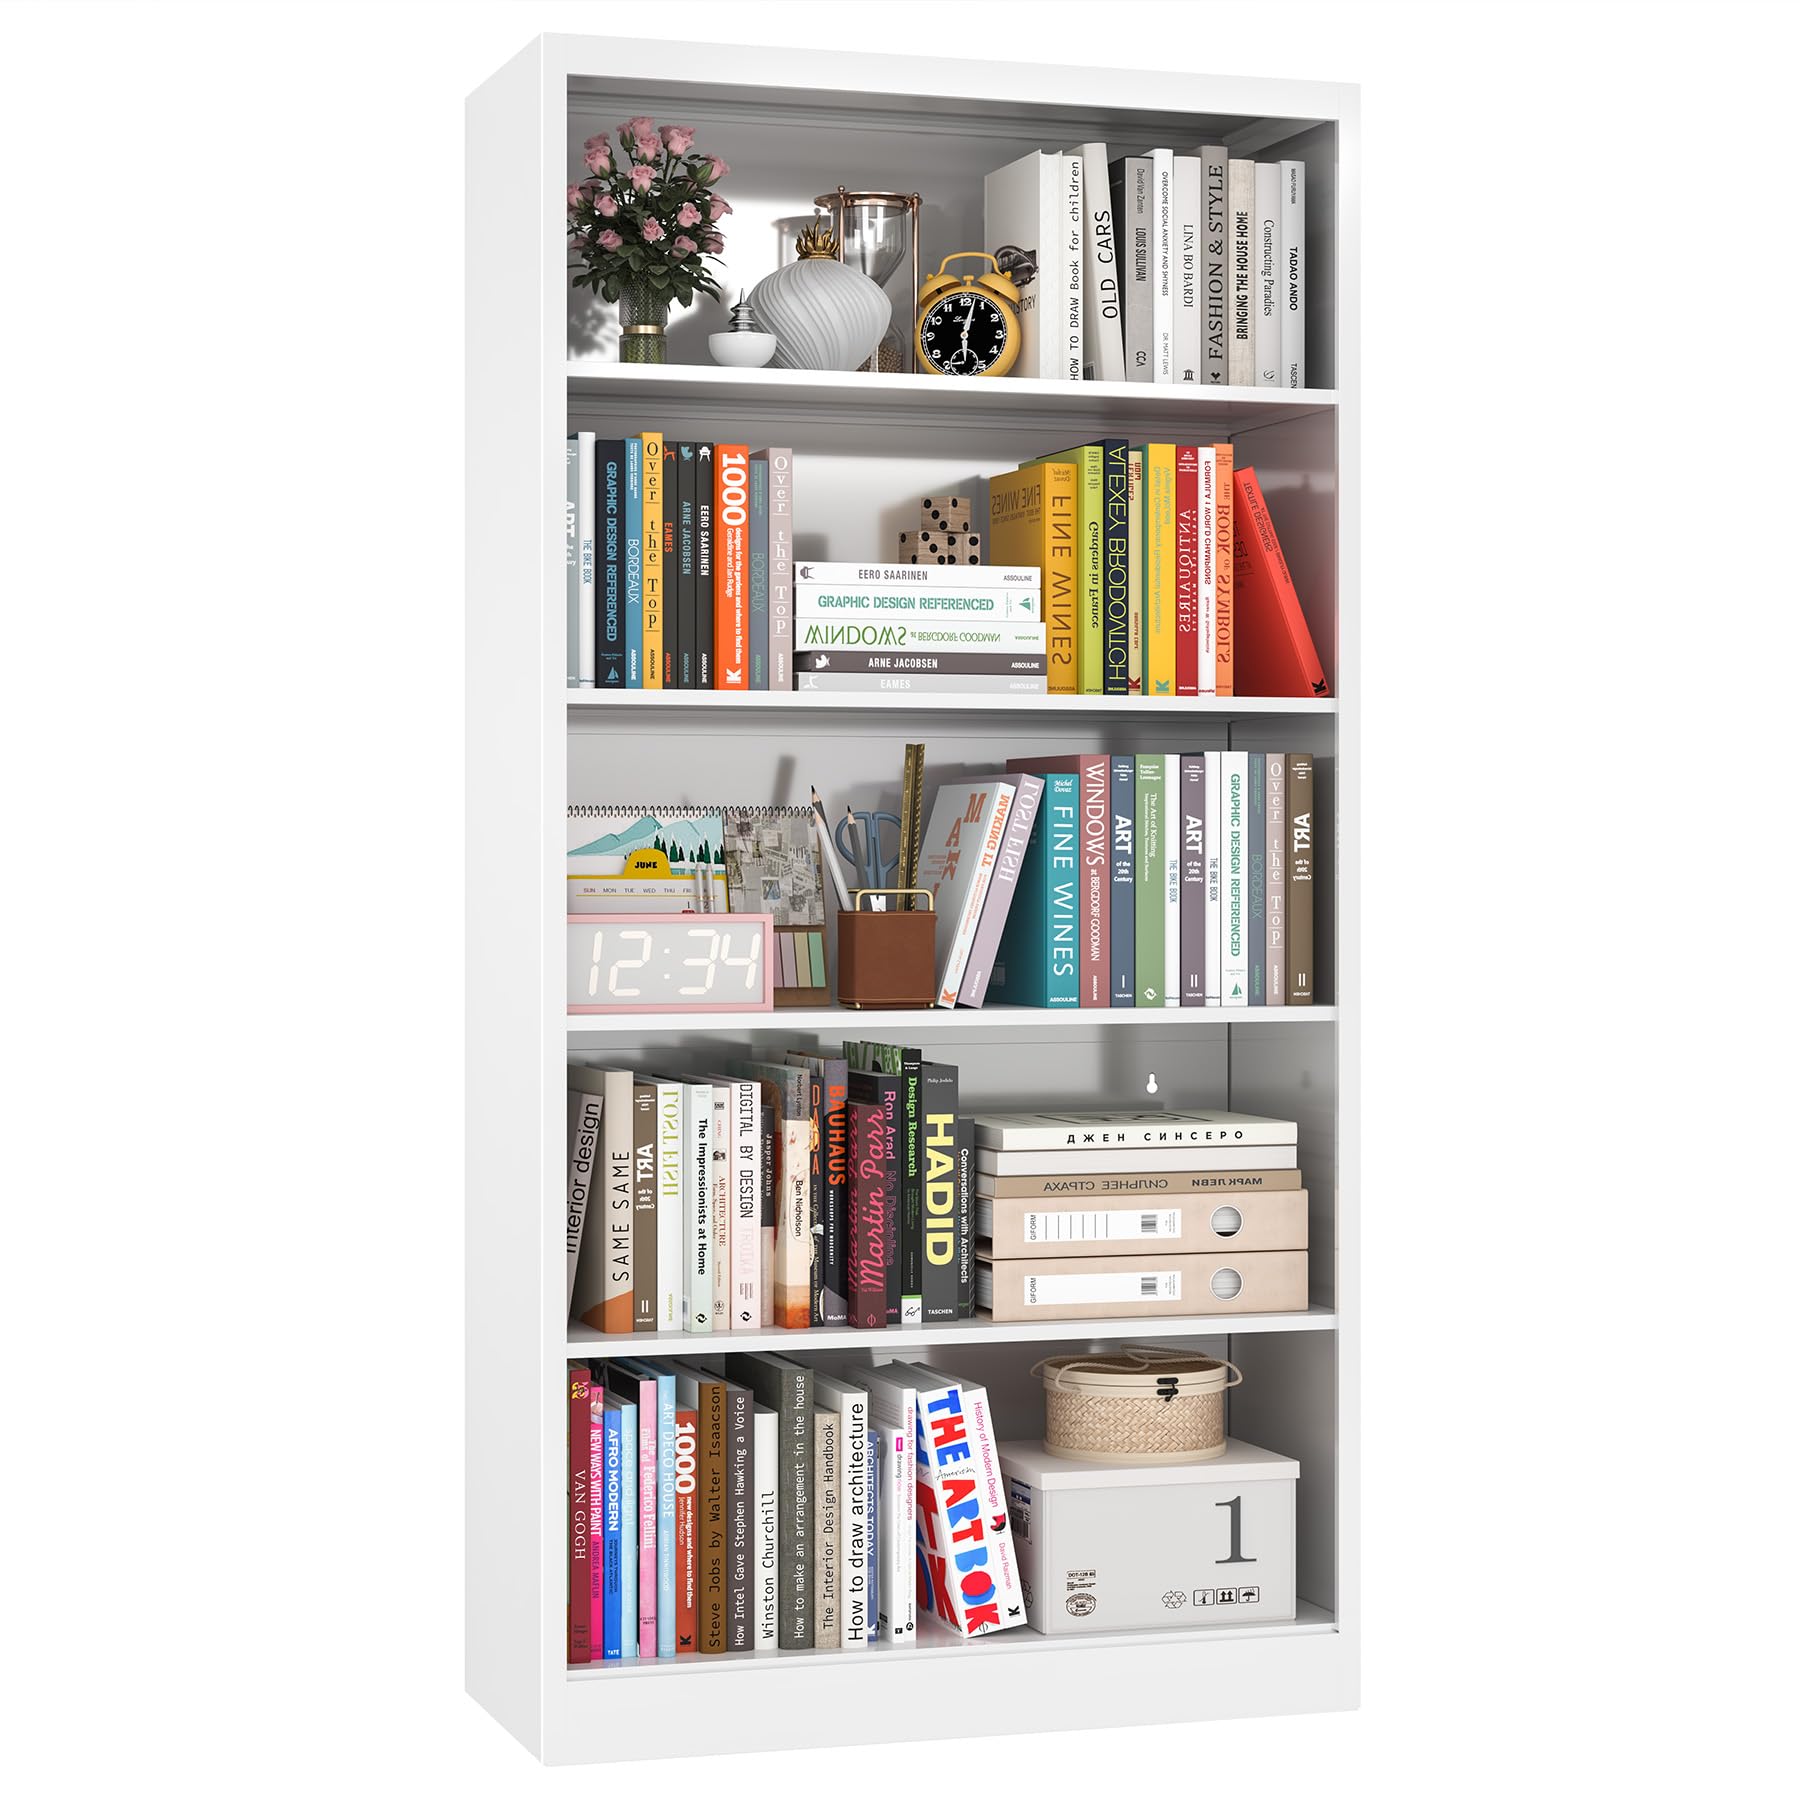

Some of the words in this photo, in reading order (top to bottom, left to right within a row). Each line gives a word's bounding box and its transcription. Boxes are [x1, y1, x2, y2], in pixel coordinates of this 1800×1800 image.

[1069, 162, 1080, 222] children
[1208, 166, 1222, 232] STYLE
[1069, 230, 1080, 252] for
[1094, 210, 1114, 263] CARS
[1136, 228, 1146, 248] LOUIS
[1184, 224, 1194, 250] LINA
[1236, 212, 1248, 238] HOME
[1136, 248, 1146, 281] SULLIVAN
[1184, 254, 1194, 269] BO
[1208, 240, 1222, 255] &
[1236, 240, 1248, 272] HOUSE
[1261, 220, 1274, 276] Constructing
[1290, 247, 1298, 280] TADAO
[1070, 260, 1080, 290] Book
[1184, 273, 1194, 308] BARDI
[1236, 274, 1248, 292] THE
[1070, 297, 1080, 328] DRAW
[1101, 279, 1118, 318] OLD
[1208, 263, 1222, 360] FASHION
[1264, 280, 1274, 316] Paradies
[1290, 282, 1298, 310] ANDO
[1236, 294, 1248, 340] BRINGING
[1070, 335, 1080, 350] TO
[1136, 351, 1146, 367] CCA
[1070, 358, 1080, 380] HOW
[606, 461, 617, 514] GRAPHIC
[646, 442, 658, 500] Over
[722, 454, 746, 526] 1000
[606, 518, 617, 562] DESIGN
[648, 520, 658, 564] the
[628, 539, 640, 604] BORDEAUX
[858, 569, 881, 580] EERO
[884, 570, 928, 580] SAARINEN
[1003, 574, 1033, 582] ASSOULINE
[606, 564, 617, 642] REFERENCED
[648, 578, 658, 628] Top
[818, 595, 870, 608] GRAPHIC
[874, 596, 916, 610] DESIGN
[920, 598, 994, 610] REFERENCED
[868, 658, 891, 668] ARNE
[894, 658, 938, 668] JACOBSEN
[1086, 762, 1104, 865] WINDOWS
[1231, 774, 1240, 827] GRAPHIC
[1054, 806, 1074, 868] FINE
[1116, 815, 1132, 854] ART
[1186, 815, 1202, 854] ART
[1231, 831, 1240, 874] DESIGN
[1054, 882, 1074, 976] WINES
[1231, 878, 1240, 956] REFERENCED
[588, 929, 761, 996] 12:34
[740, 1084, 754, 1137] DIGITAL
[906, 1077, 918, 1120] Design
[698, 1118, 708, 1140] The
[828, 1085, 845, 1185] BAUHAUS
[1067, 1133, 1126, 1144] ДЖЕН
[1144, 1130, 1244, 1142] СИНСЕРО
[740, 1146, 754, 1160] BY
[908, 1122, 918, 1177] Research
[613, 1152, 630, 1209] SAME
[697, 1142, 708, 1225] Impressionists
[740, 1170, 754, 1218] DESIGN
[796, 1180, 804, 1194] Ben
[926, 1114, 954, 1266] HADID
[960, 1148, 968, 1214] Conversations
[698, 1229, 707, 1240] at
[796, 1196, 804, 1237] Nicholson
[960, 1216, 968, 1235] with
[613, 1224, 630, 1281] SAME
[698, 1243, 707, 1276] Home
[960, 1238, 968, 1284] Architects
[794, 1376, 804, 1409] house
[663, 1403, 674, 1426] ART
[709, 1386, 720, 1457] Isaacson
[734, 1396, 745, 1430] Voice
[794, 1416, 804, 1436] the
[928, 1389, 971, 1467] THE
[974, 1402, 986, 1434] History
[590, 1429, 602, 1450] NEW
[608, 1428, 618, 1468] AFRO
[663, 1432, 674, 1470] DECO
[794, 1441, 804, 1456] in
[822, 1423, 834, 1482] Handbook
[980, 1433, 986, 1443] of
[590, 1451, 602, 1481] WAYS
[676, 1422, 696, 1494] 1000
[734, 1449, 747, 1496] Hawking
[848, 1403, 864, 1515] architecture
[982, 1443, 994, 1478] Modern
[574, 1470, 586, 1504] VAN
[590, 1482, 602, 1506] WITH
[608, 1470, 618, 1531] MODERN
[663, 1472, 674, 1518] HOUSE
[708, 1469, 720, 1522] Walter
[794, 1463, 807, 1536] arrangement
[986, 1477, 998, 1508] Design
[590, 1508, 602, 1536] PAINT
[734, 1502, 747, 1548] Stephen
[762, 1490, 774, 1568] Churchill
[822, 1490, 836, 1534] Design
[942, 1479, 984, 1543] ART
[1216, 1496, 1257, 1564] 1
[574, 1511, 586, 1560] GOGH
[708, 1530, 723, 1548] by
[796, 1544, 805, 1556] an
[848, 1523, 864, 1568] draw
[709, 1558, 720, 1592] Jobs
[734, 1554, 745, 1580] Gave
[794, 1564, 805, 1592] make
[822, 1542, 834, 1599] Interior
[848, 1576, 864, 1593] to
[734, 1587, 745, 1619] Intel
[762, 1578, 774, 1638] Winston
[794, 1598, 805, 1610] to
[823, 1607, 834, 1629] The
[848, 1600, 864, 1640] How
[709, 1603, 720, 1647] Steve
[734, 1625, 745, 1646] How
[794, 1618, 805, 1638] How
